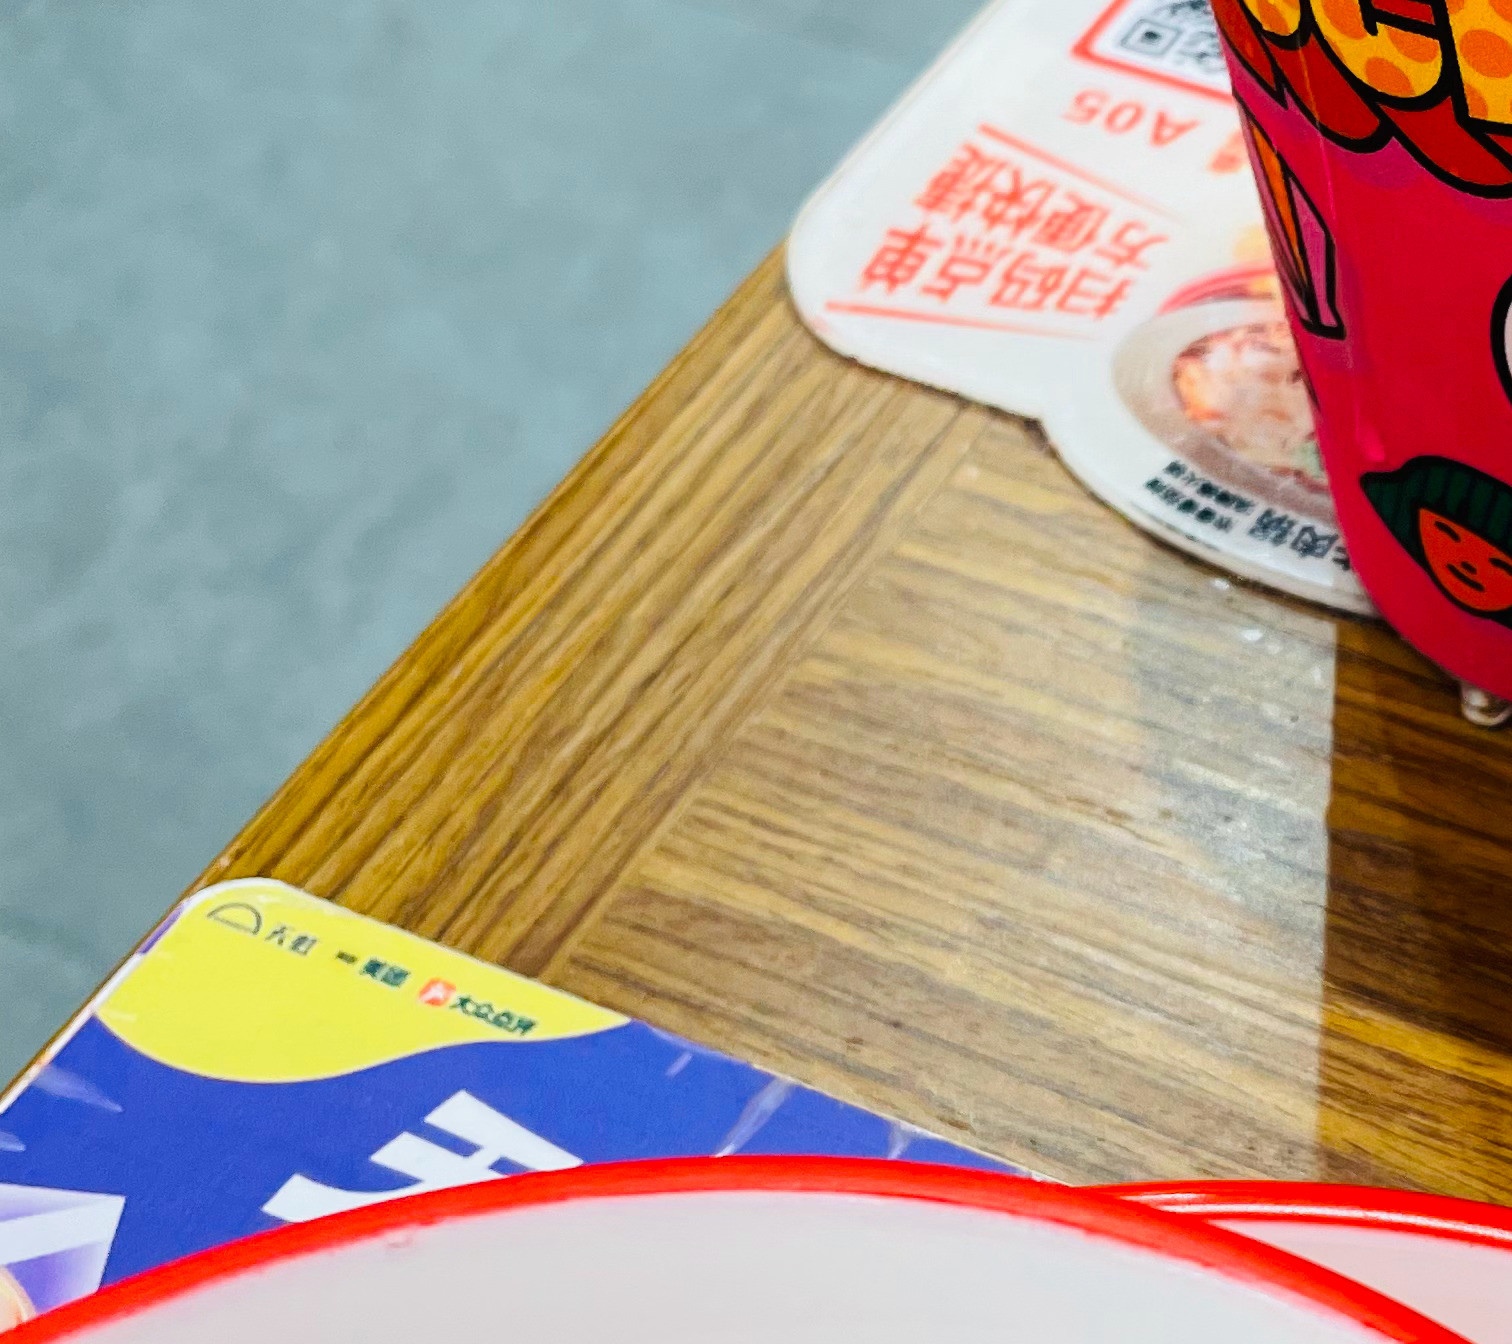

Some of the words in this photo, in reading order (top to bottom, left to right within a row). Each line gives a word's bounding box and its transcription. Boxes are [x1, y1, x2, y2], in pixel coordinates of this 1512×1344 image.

[1061, 88, 1200, 147] A05
[914, 141, 1169, 271] 方便快捷
[859, 222, 1133, 318] 扫码点单
